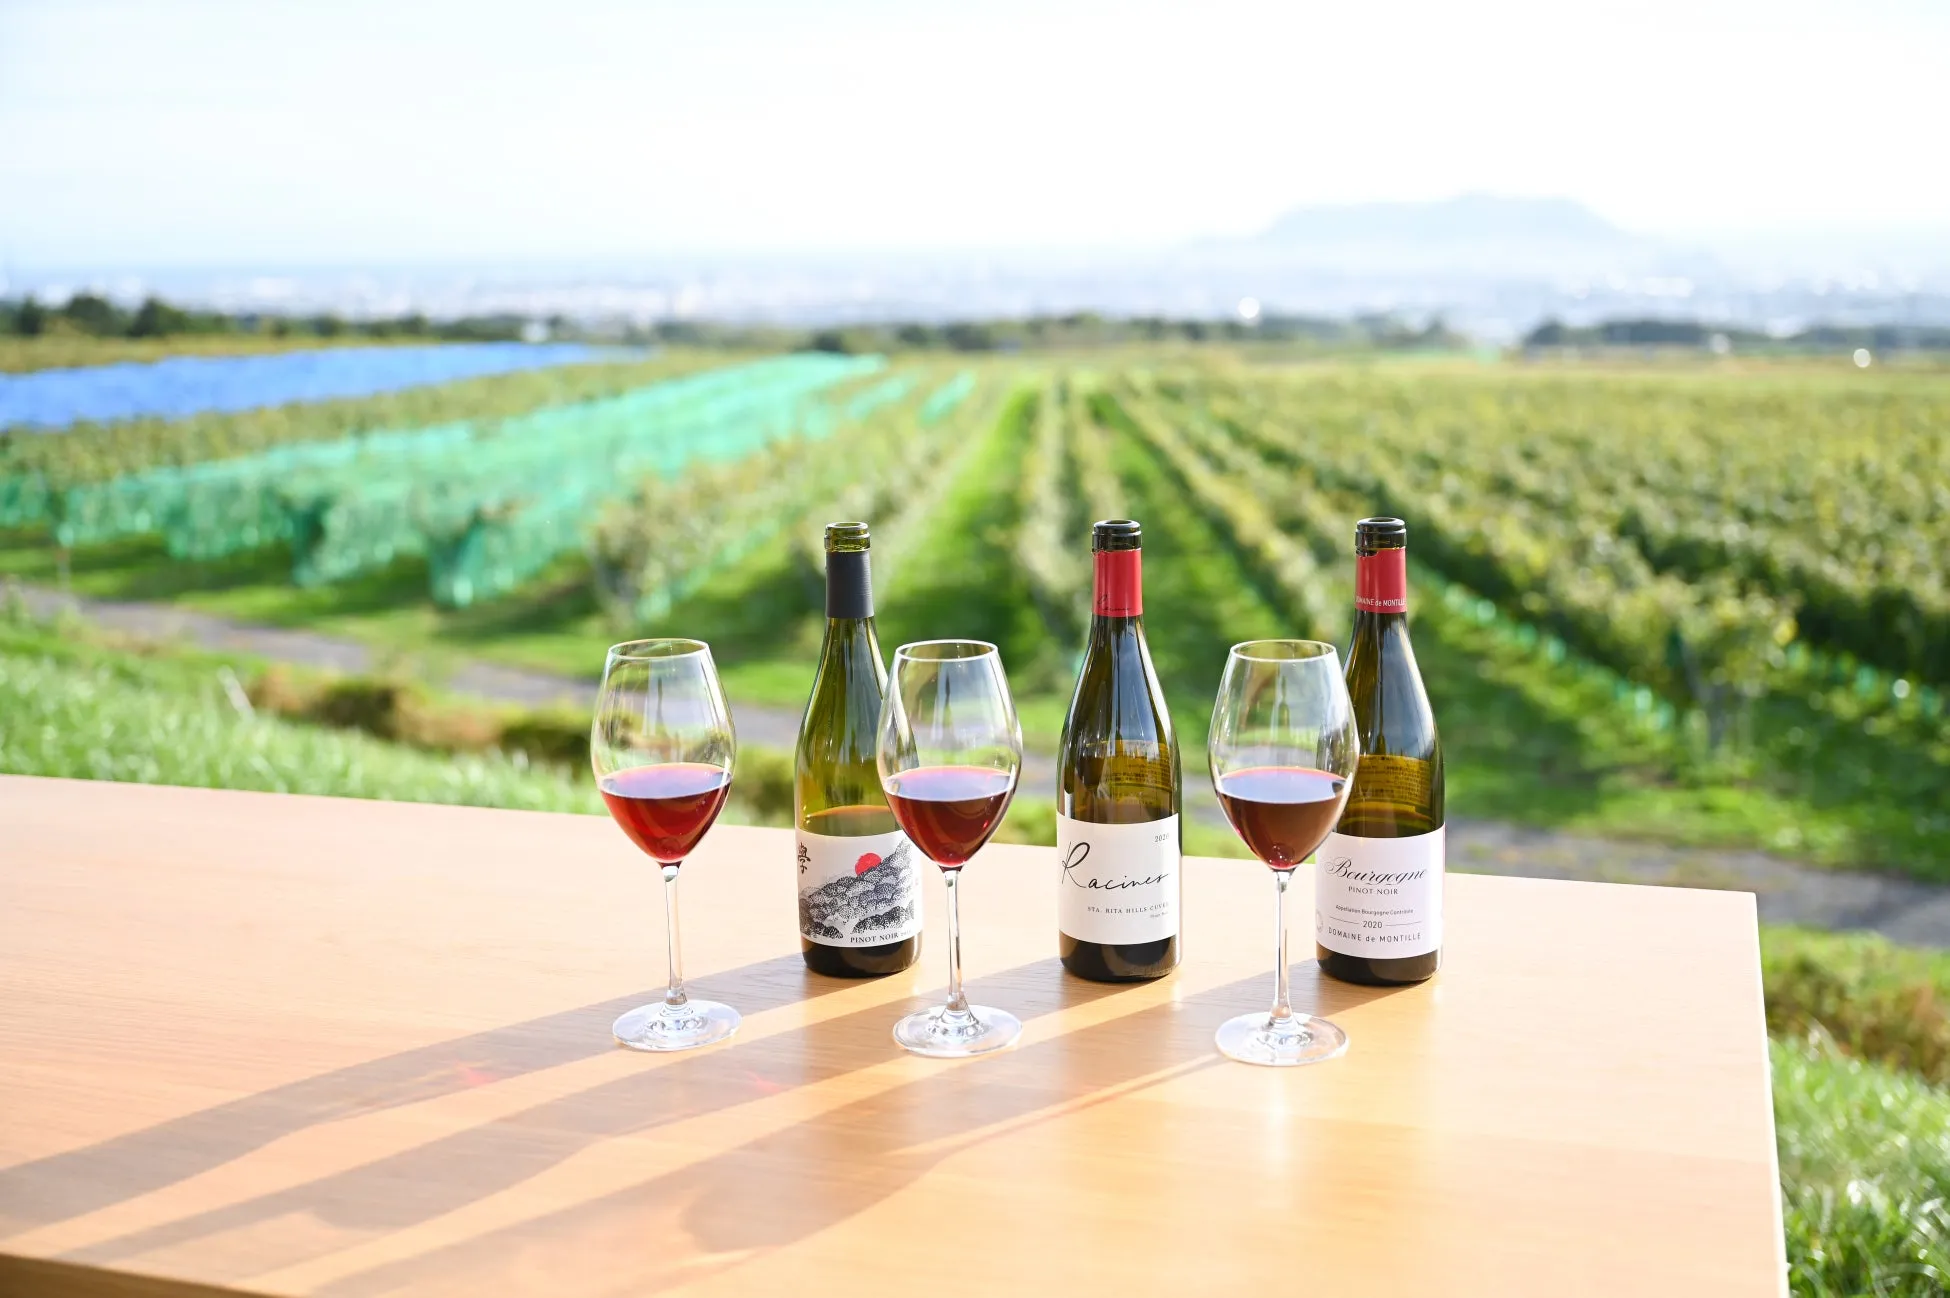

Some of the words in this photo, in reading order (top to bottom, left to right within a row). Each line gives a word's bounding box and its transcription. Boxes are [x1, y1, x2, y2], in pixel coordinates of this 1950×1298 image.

[1375, 599, 1382, 607] de
[1061, 841, 1168, 890] Racines
[1325, 856, 1427, 886] Bourgogne
[1348, 886, 1373, 895] PINOT
[1126, 906, 1147, 914] HILLS
[1361, 908, 1389, 916] Bourgogne
[1362, 920, 1383, 929] 2020
[850, 935, 877, 943] PINOT
[879, 932, 899, 941] NOIR
[1328, 926, 1361, 941] DOMAINE
[1379, 932, 1421, 942] MONTILLE
